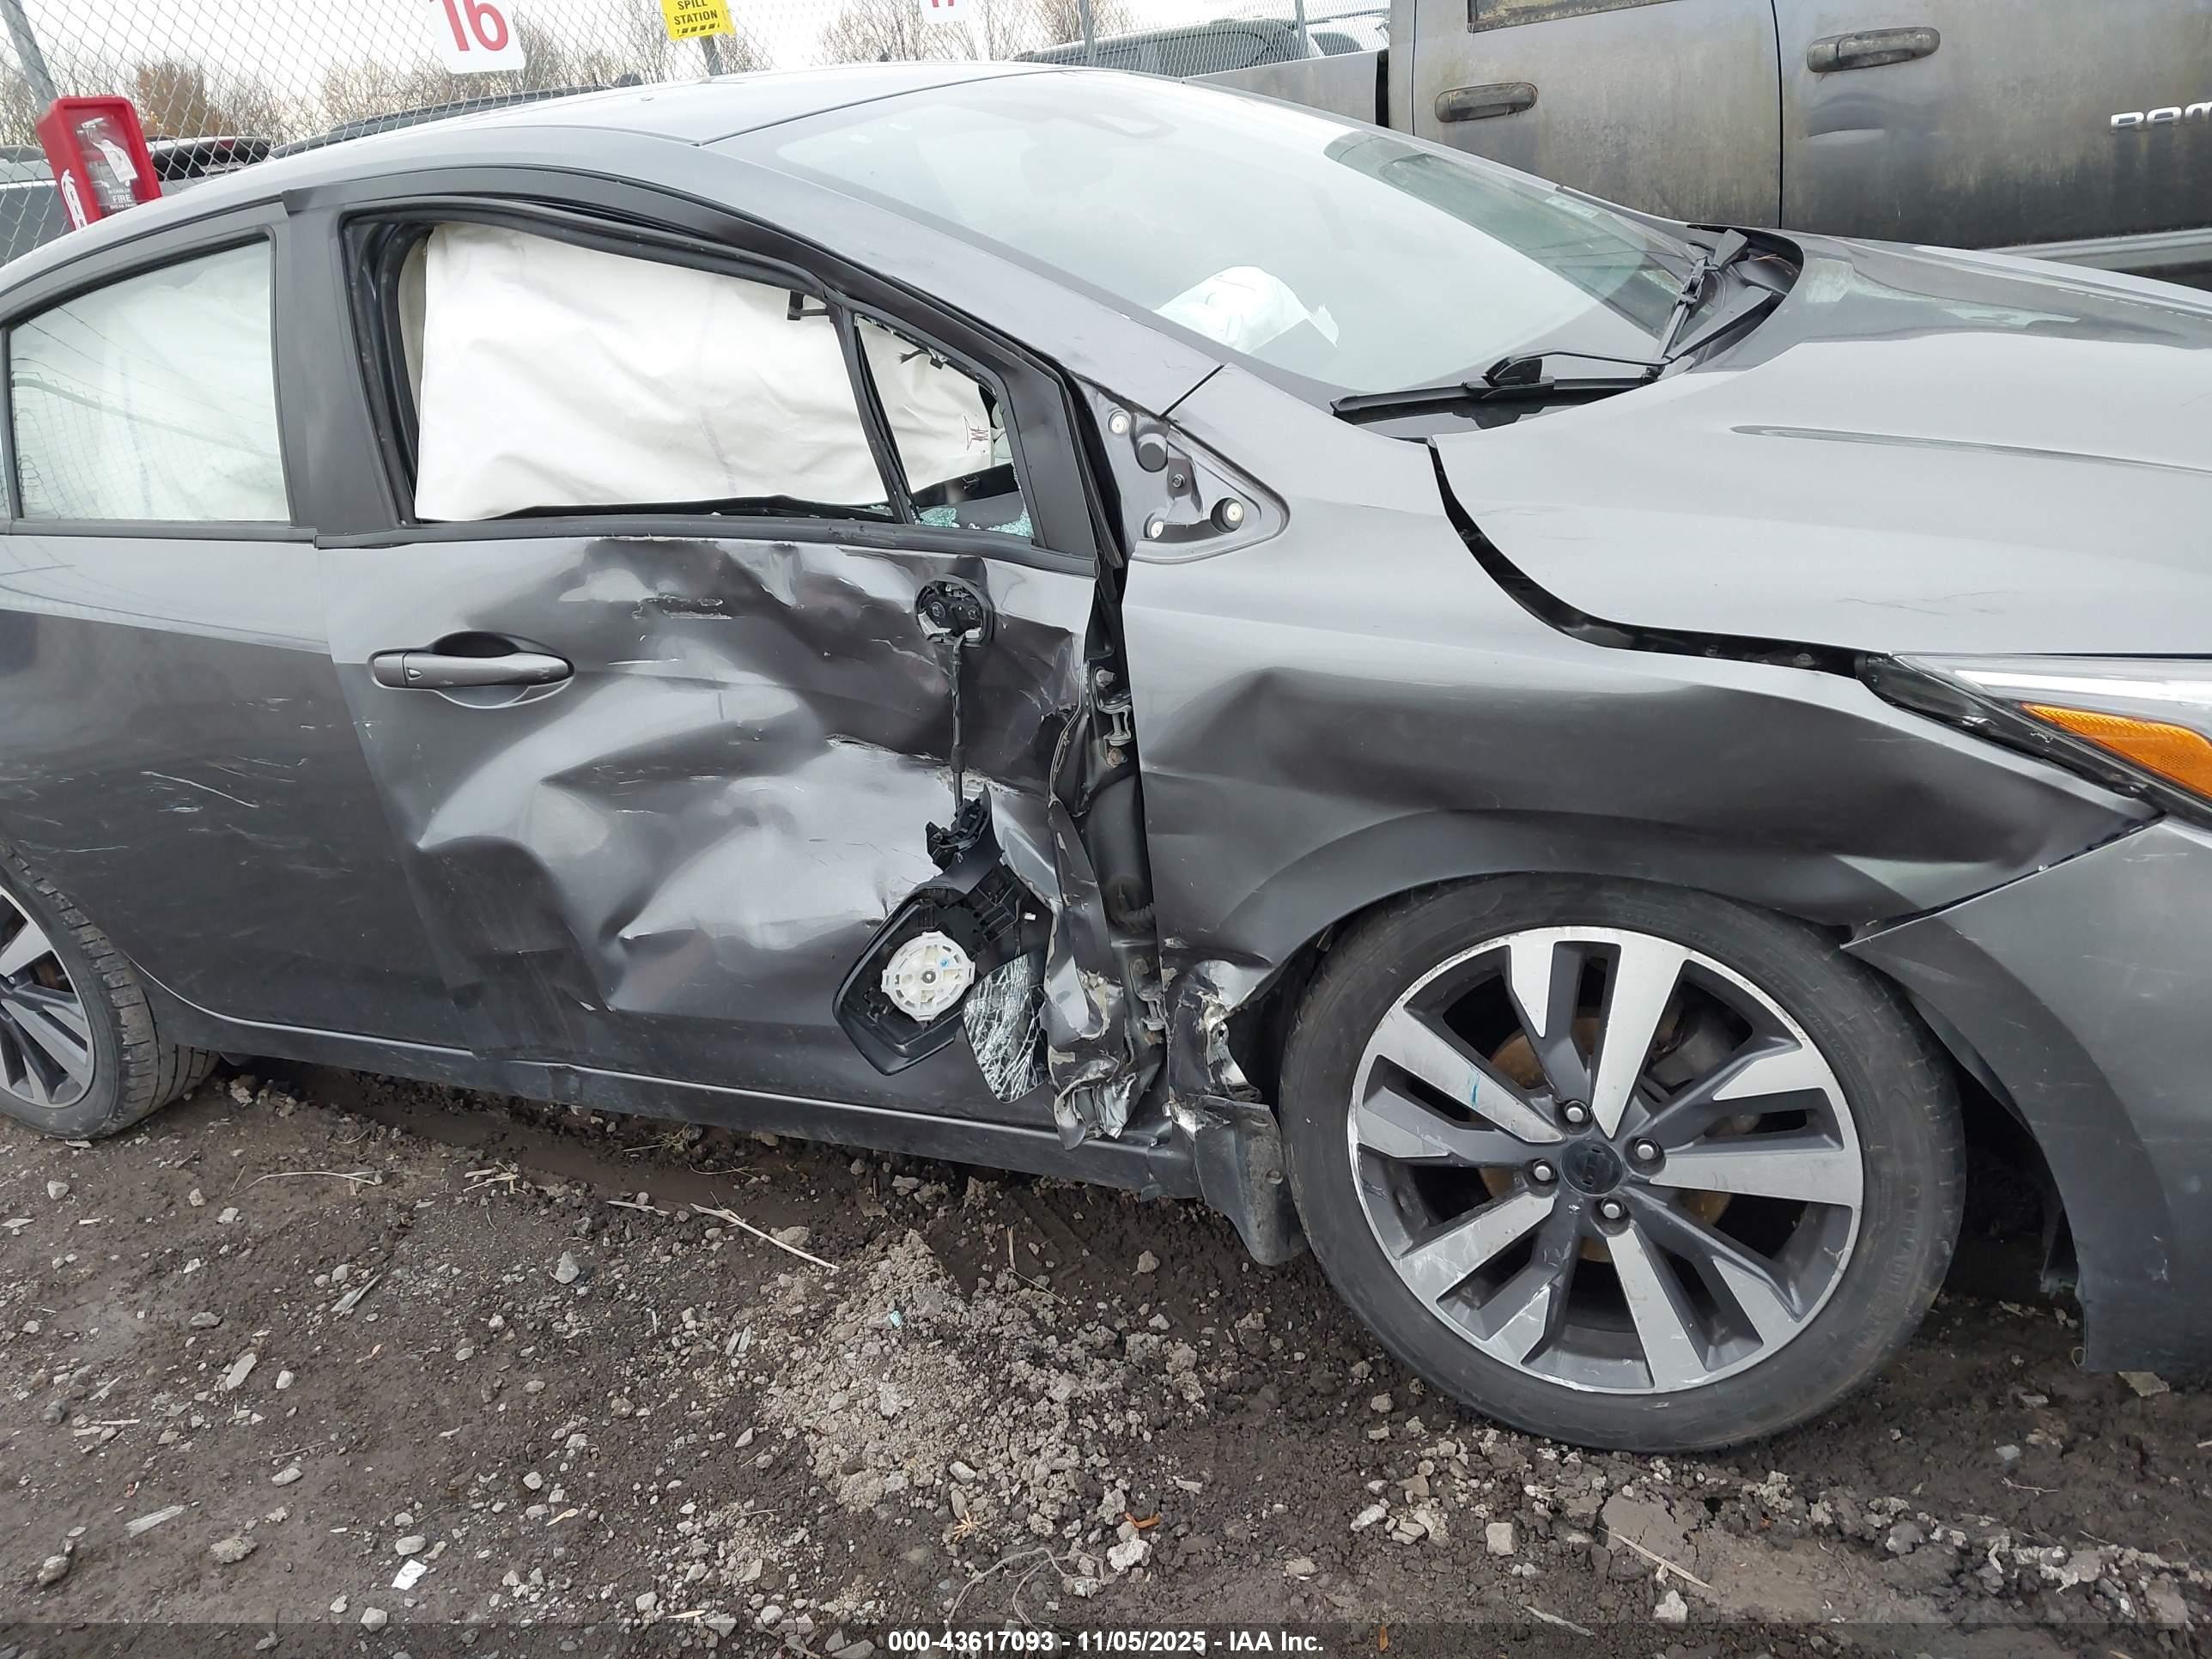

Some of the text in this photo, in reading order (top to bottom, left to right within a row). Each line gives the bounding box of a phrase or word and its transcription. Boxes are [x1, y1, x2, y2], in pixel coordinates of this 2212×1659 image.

[677, 0, 708, 10] SPILL
[673, 9, 718, 26] STATION
[430, 0, 508, 52] 16
[112, 194, 132, 204] FIRE
